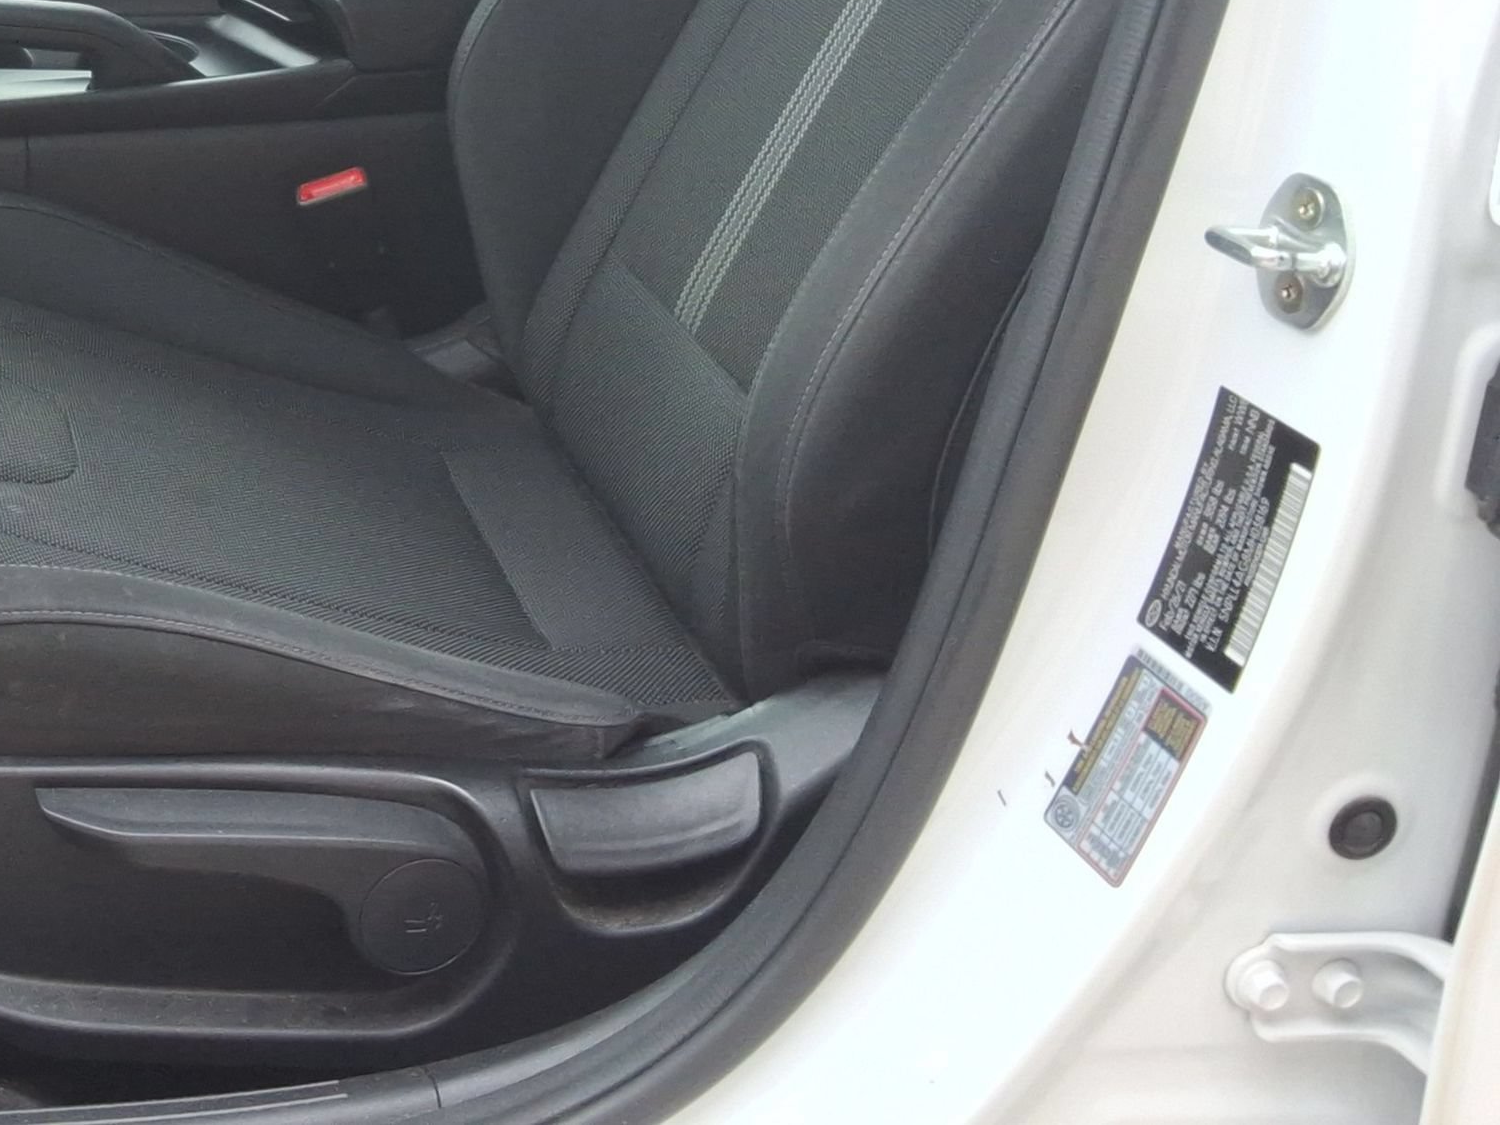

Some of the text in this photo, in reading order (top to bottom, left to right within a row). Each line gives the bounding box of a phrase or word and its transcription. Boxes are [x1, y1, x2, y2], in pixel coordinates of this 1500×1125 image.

[1212, 479, 1225, 496] lbs
[1224, 488, 1236, 504] lbs
[1162, 561, 1181, 600] HYUNDAI
[1226, 394, 1239, 414] LLC
